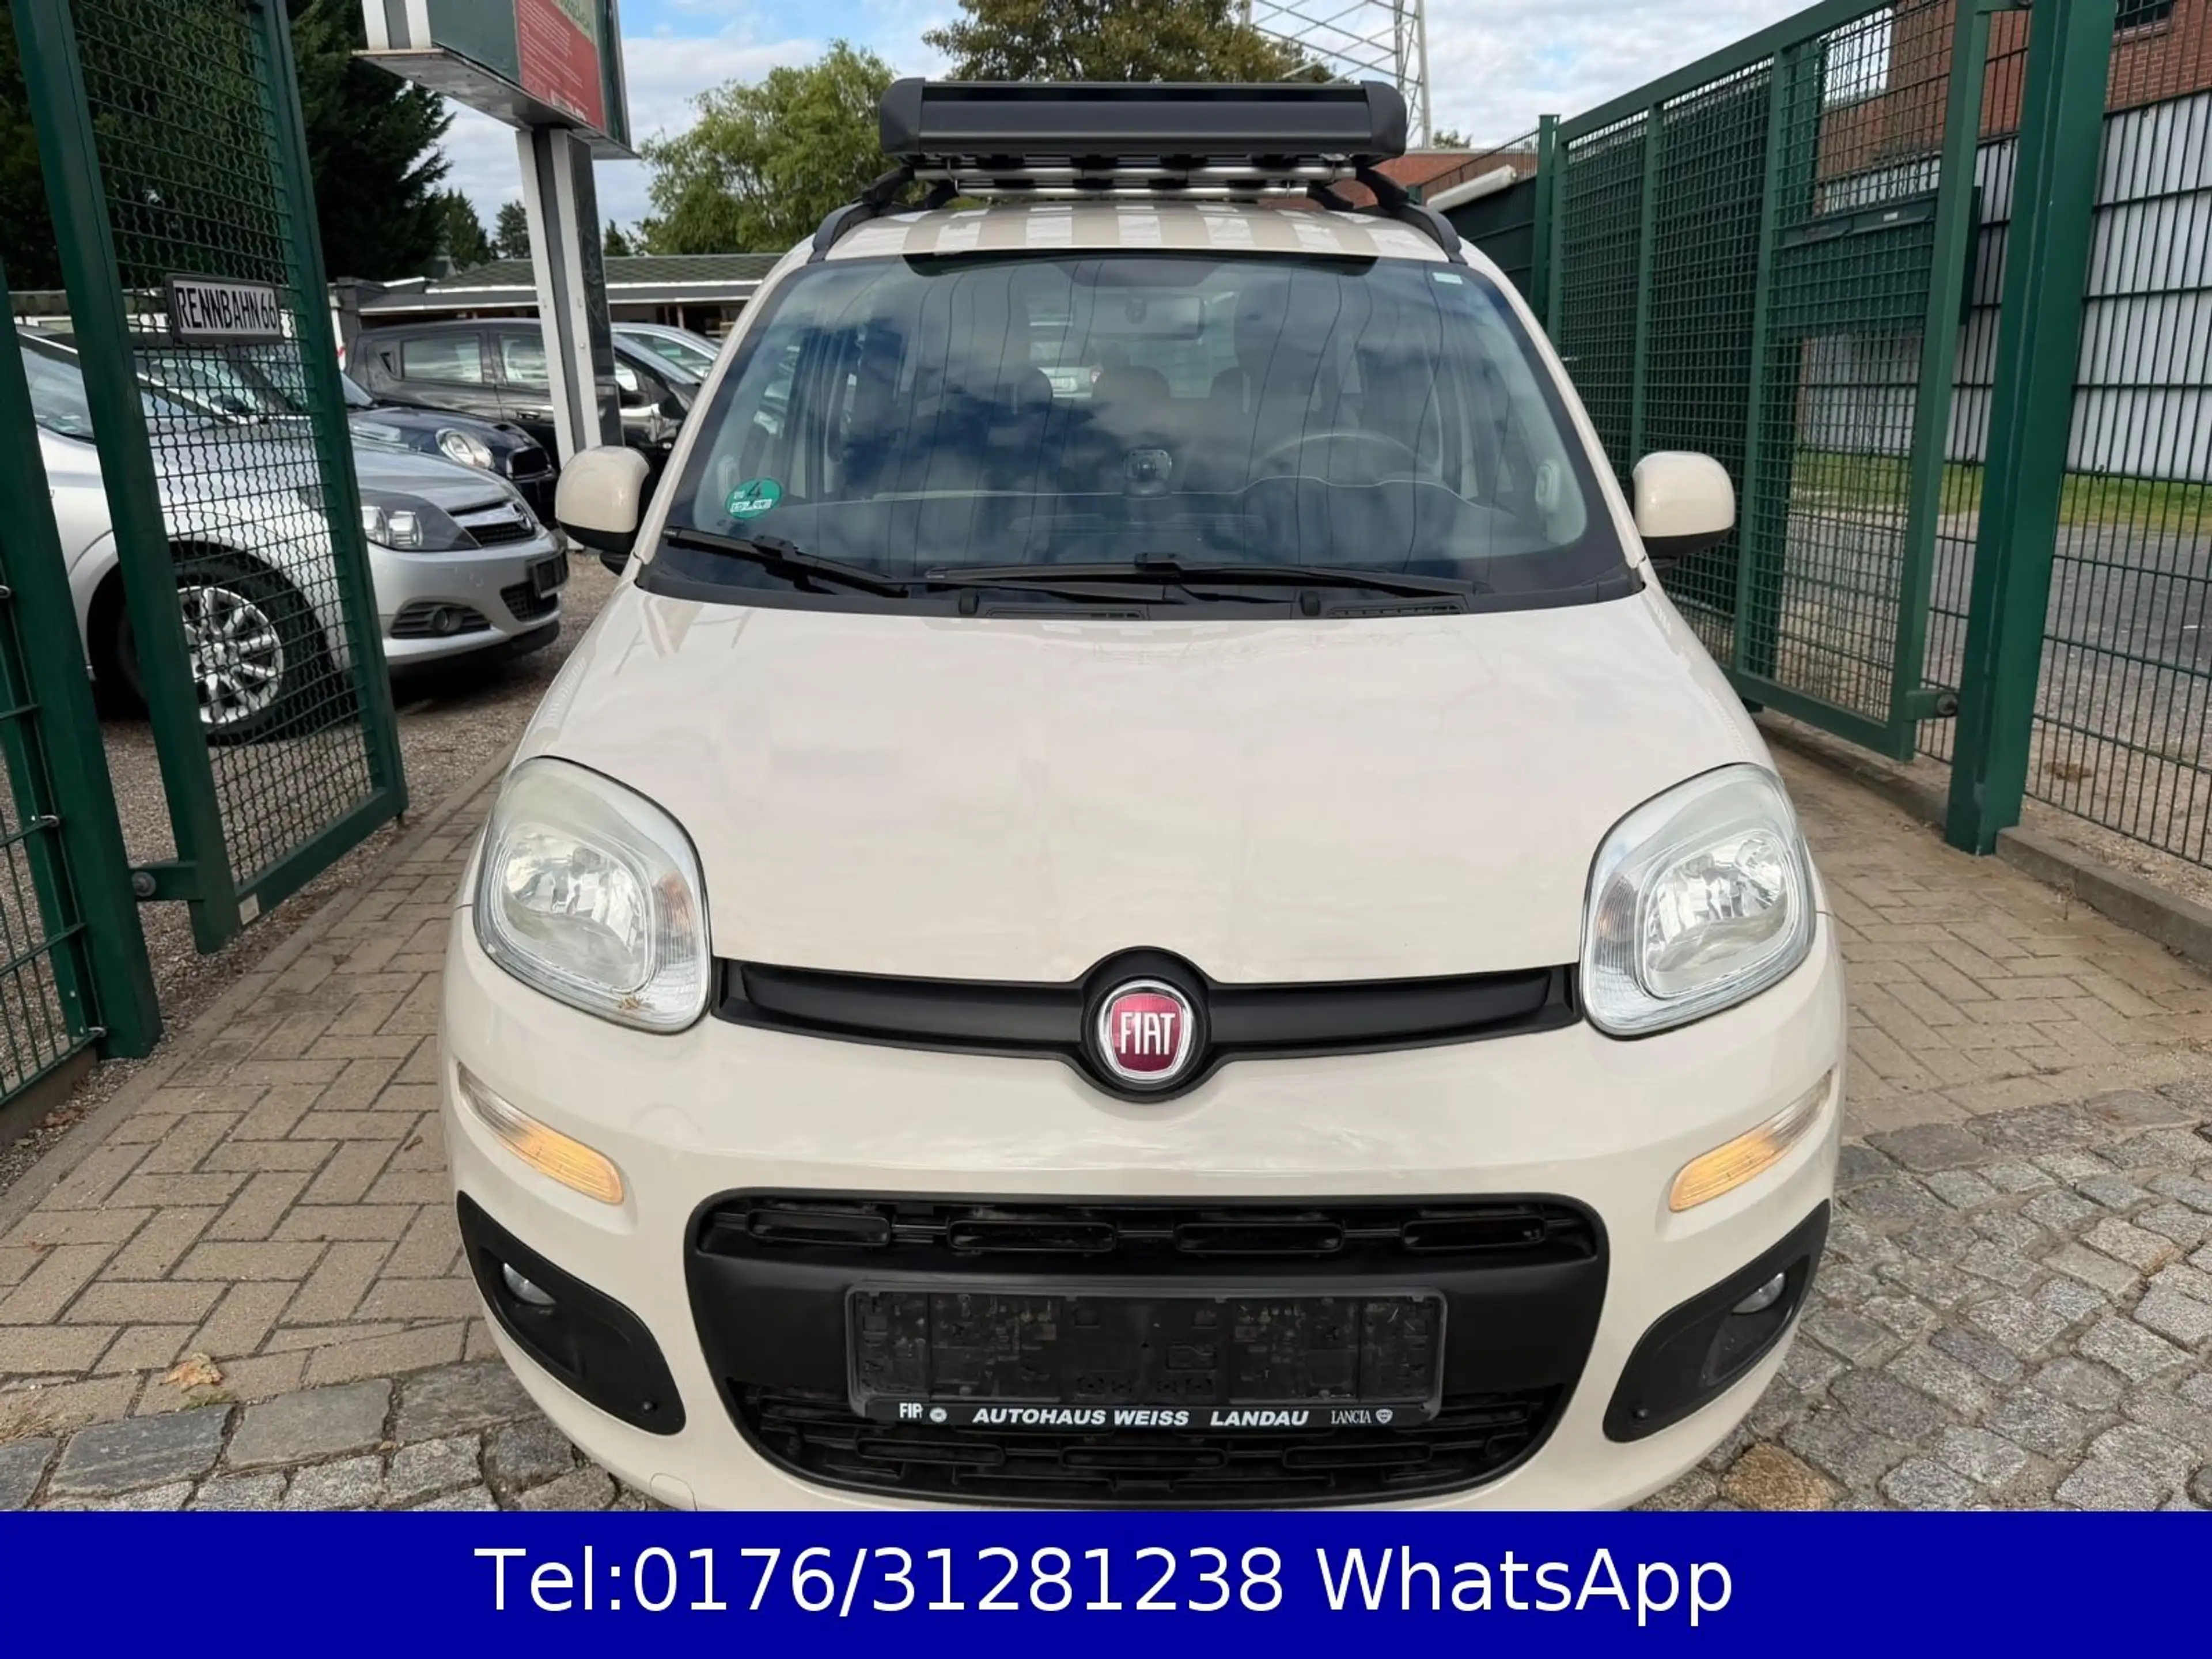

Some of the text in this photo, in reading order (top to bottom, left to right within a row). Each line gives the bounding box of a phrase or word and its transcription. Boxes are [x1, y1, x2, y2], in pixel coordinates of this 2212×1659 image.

[175, 287, 278, 329] RENNBAHN 66
[1119, 1011, 1176, 1056] FIAT
[972, 1408, 1309, 1426] AUTOHAUS WEISS LANDAU
[1330, 1410, 1372, 1425] LANCIA
